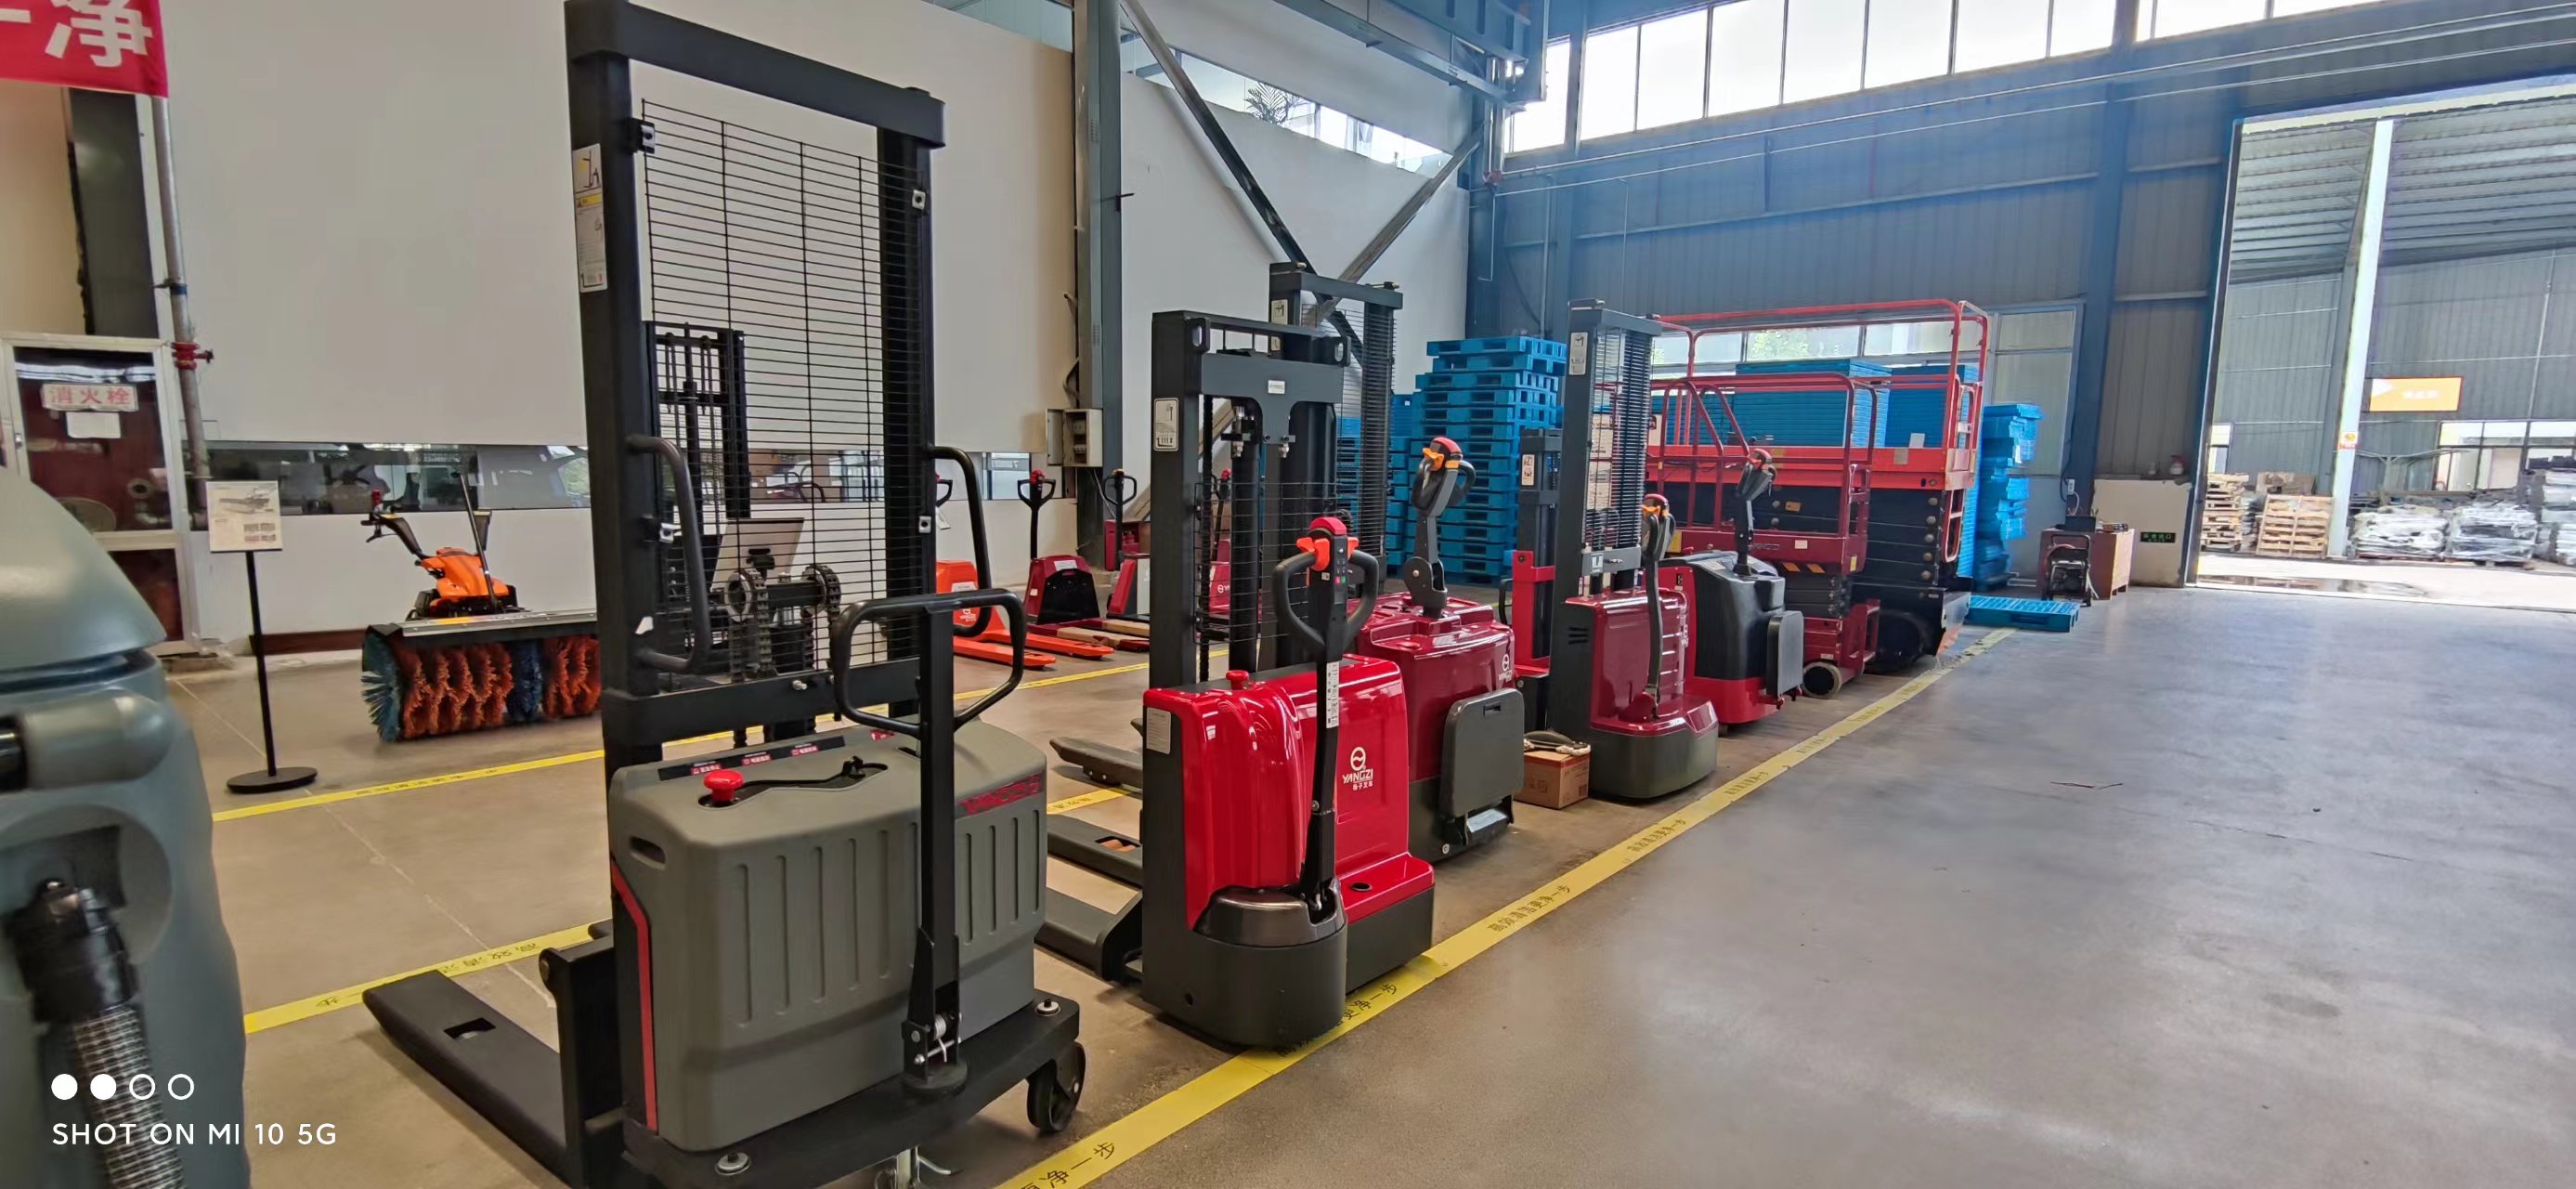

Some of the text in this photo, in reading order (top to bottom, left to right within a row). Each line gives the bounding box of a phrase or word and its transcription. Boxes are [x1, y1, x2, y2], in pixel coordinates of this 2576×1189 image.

[51, 385, 131, 405] 消火栓
[1342, 768, 1373, 784] YANGZI
